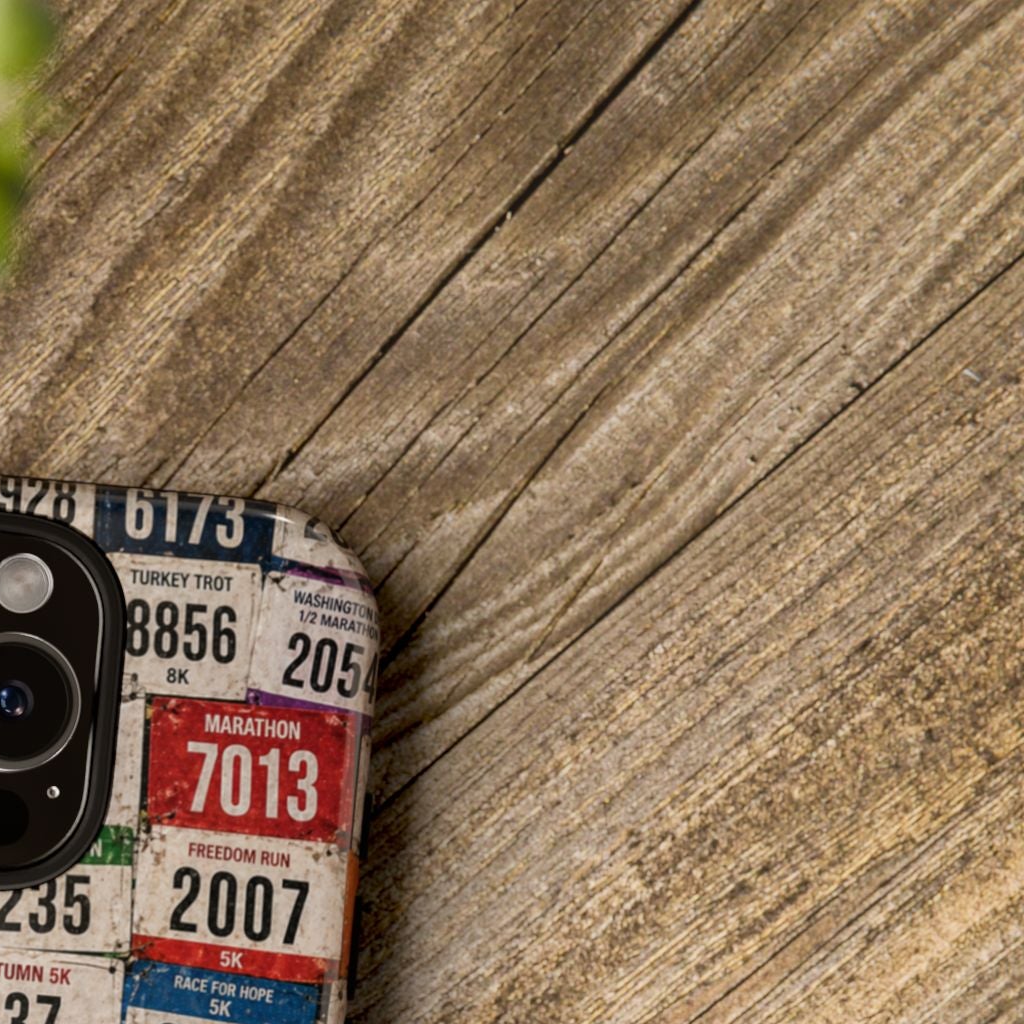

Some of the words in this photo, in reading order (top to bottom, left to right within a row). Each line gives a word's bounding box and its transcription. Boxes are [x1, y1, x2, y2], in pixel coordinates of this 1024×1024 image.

[126, 488, 245, 548] 6173
[131, 569, 189, 588] TURKEY
[195, 574, 232, 591] TROT
[125, 599, 237, 664] 8856
[299, 610, 317, 624] 1/2
[320, 614, 378, 640] MARATHO
[166, 668, 189, 684] 8K
[282, 632, 378, 704] 2054
[205, 714, 301, 740] MARATHON
[187, 741, 318, 822] 7013
[188, 842, 256, 864] FREEDOM
[261, 851, 291, 868] RUN
[169, 866, 310, 945] 2007
[219, 951, 243, 968] 5K
[49, 967, 71, 985] 5K
[174, 975, 209, 995] RACE
[212, 981, 236, 998] FOR
[239, 986, 274, 1003] HOPE
[209, 999, 230, 1017] 5K
